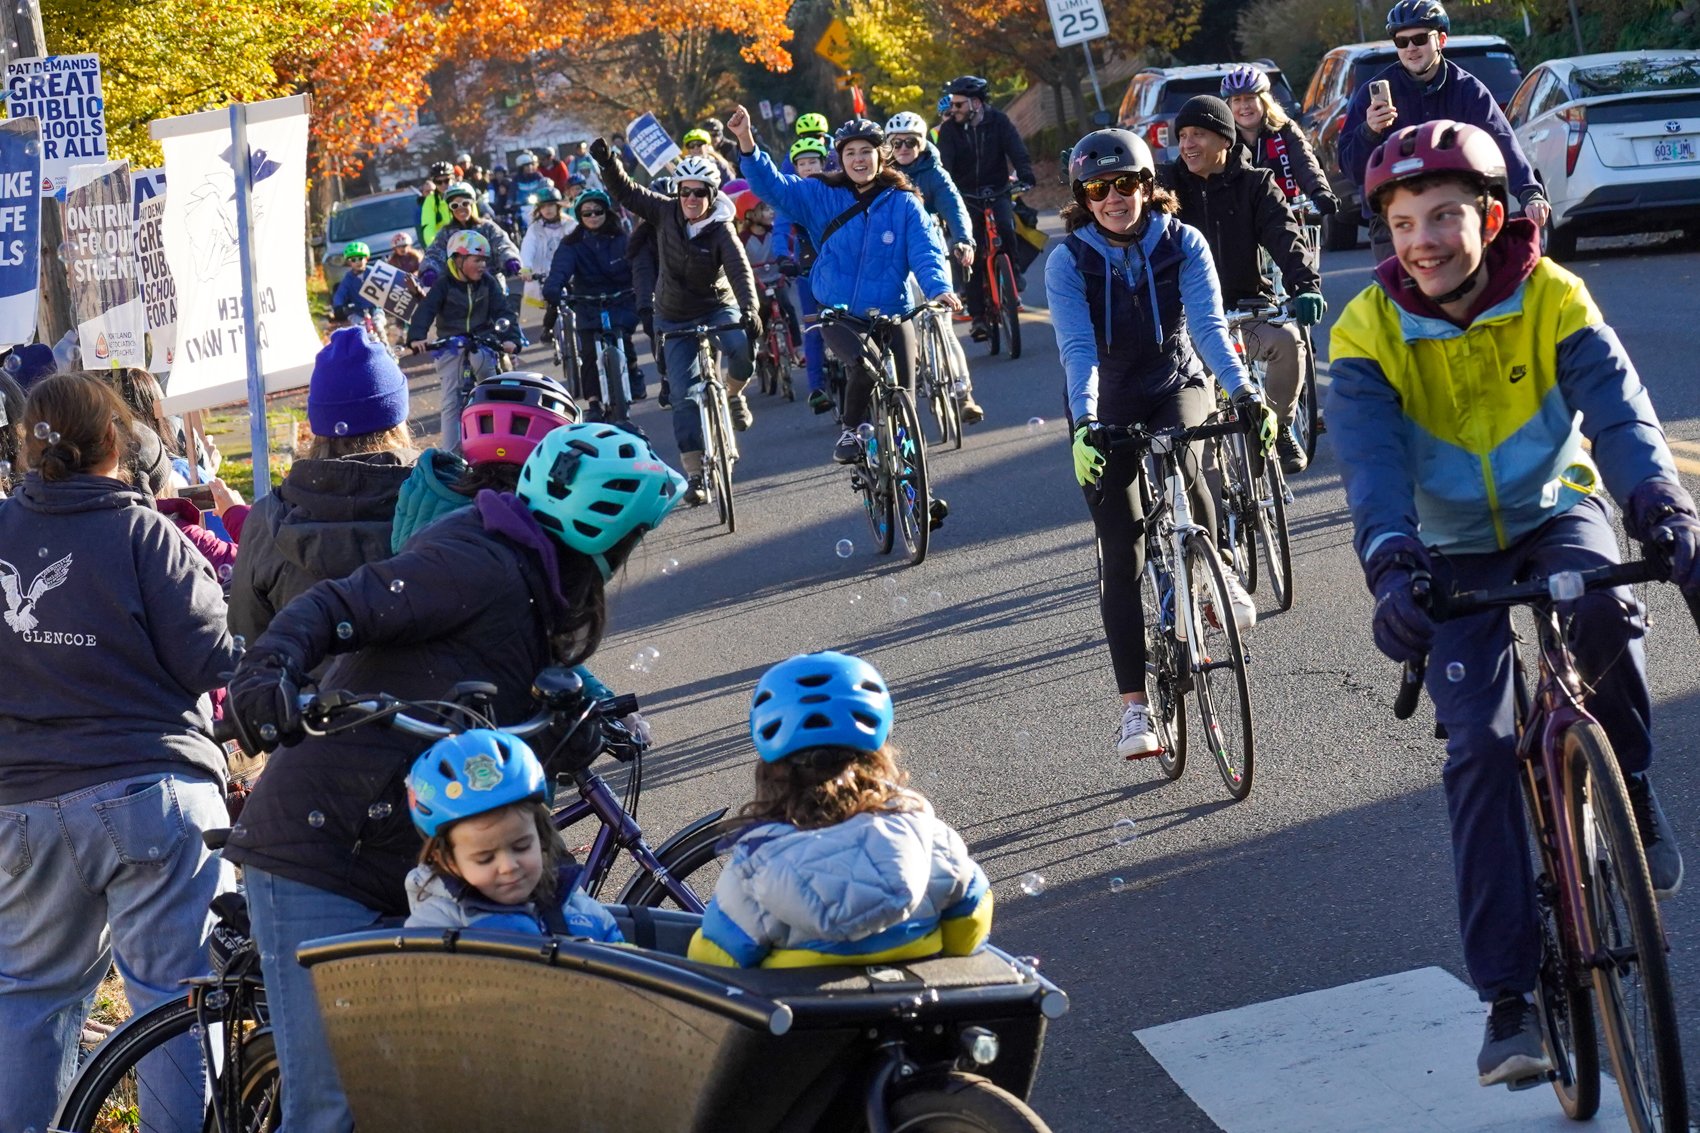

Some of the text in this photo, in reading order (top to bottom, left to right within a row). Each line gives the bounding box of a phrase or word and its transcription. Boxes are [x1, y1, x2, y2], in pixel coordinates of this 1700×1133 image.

[1059, 8, 1098, 37] 25
[8, 58, 97, 75] PAT DEMANDS
[9, 71, 98, 101] GREAT
[42, 119, 103, 140] HOOLS
[645, 129, 663, 143] SAFE
[64, 138, 105, 158] ALL
[640, 136, 667, 159] SCHOOLS
[1655, 144, 1672, 157] 603
[1274, 133, 1295, 190] PORTL
[68, 202, 132, 231] ON TRIK
[139, 218, 164, 254] GRE
[74, 256, 137, 283] STUDENT
[141, 250, 171, 283] PUB
[145, 279, 176, 305] SCHOO
[363, 265, 393, 301] PAT
[389, 284, 406, 303] ON
[146, 301, 168, 330] FOR
[393, 288, 413, 316] STRI
[23, 630, 97, 646] GLENCOE
